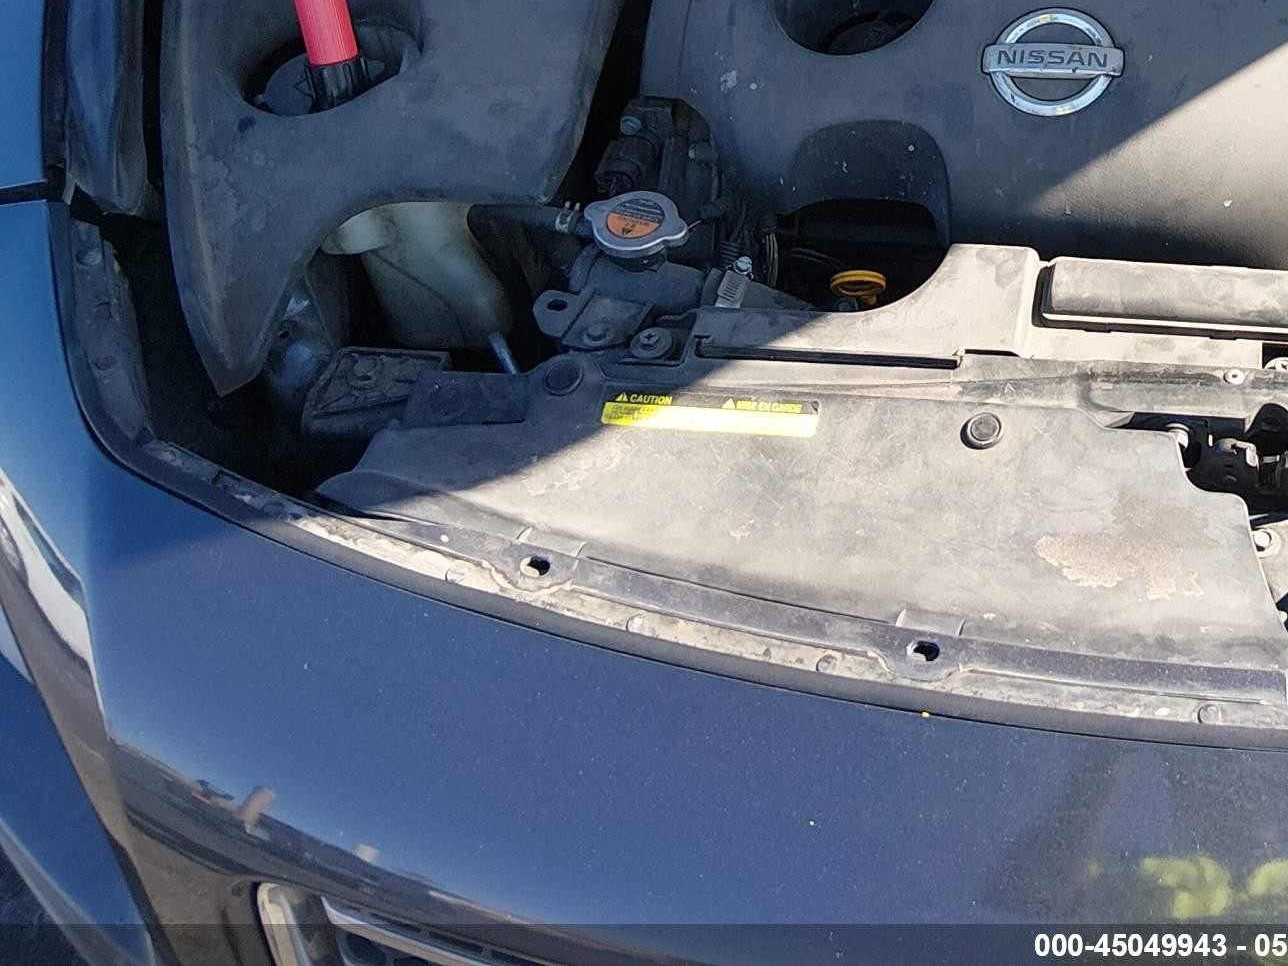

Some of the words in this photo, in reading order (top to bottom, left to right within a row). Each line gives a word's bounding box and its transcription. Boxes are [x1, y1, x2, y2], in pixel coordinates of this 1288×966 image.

[997, 49, 1108, 68] NISSAN
[629, 394, 672, 405] CAUTION
[736, 400, 757, 411] MISE
[758, 401, 771, 412] EN
[772, 402, 802, 413] GARDE
